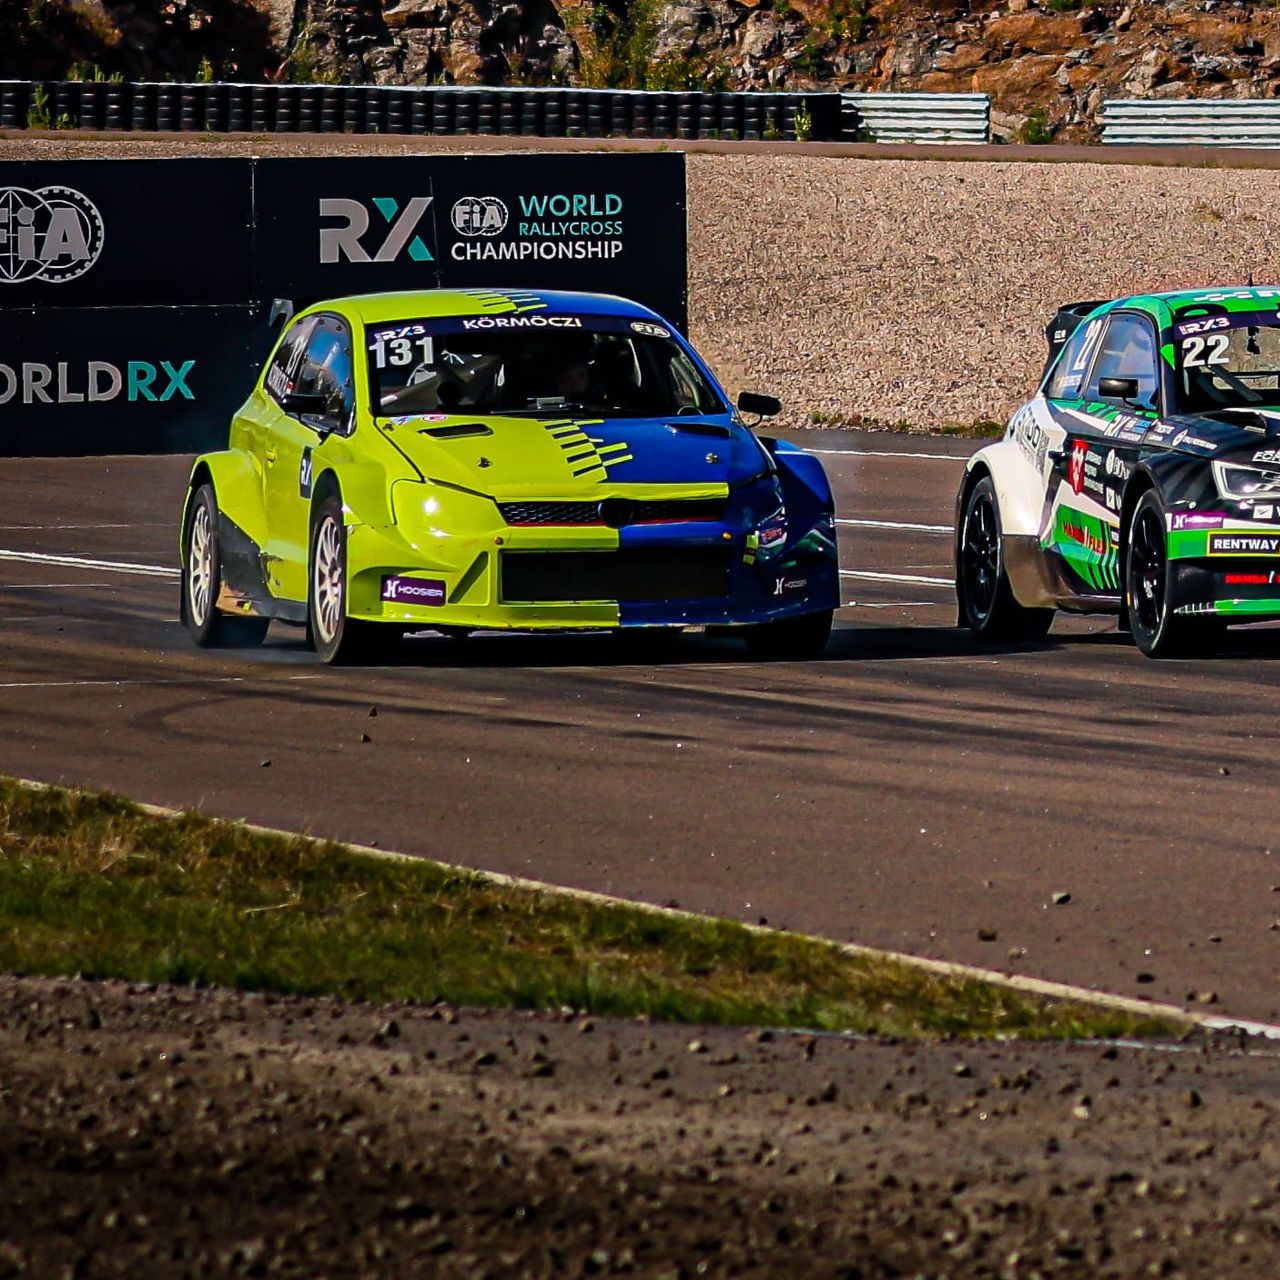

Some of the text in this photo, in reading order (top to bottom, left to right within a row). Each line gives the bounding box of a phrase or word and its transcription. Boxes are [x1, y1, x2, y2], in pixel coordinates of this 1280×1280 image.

[519, 194, 622, 217] WORLD
[320, 197, 435, 263] RX
[519, 221, 622, 236] RALLYCROSS
[450, 240, 623, 261] CHAMPIONSHIP
[463, 316, 583, 330] KÖRMÖCZI
[369, 336, 434, 368] 131
[1182, 334, 1230, 368] 22
[1214, 538, 1279, 550] RENTWAY
[398, 585, 443, 598] HOOSIER
